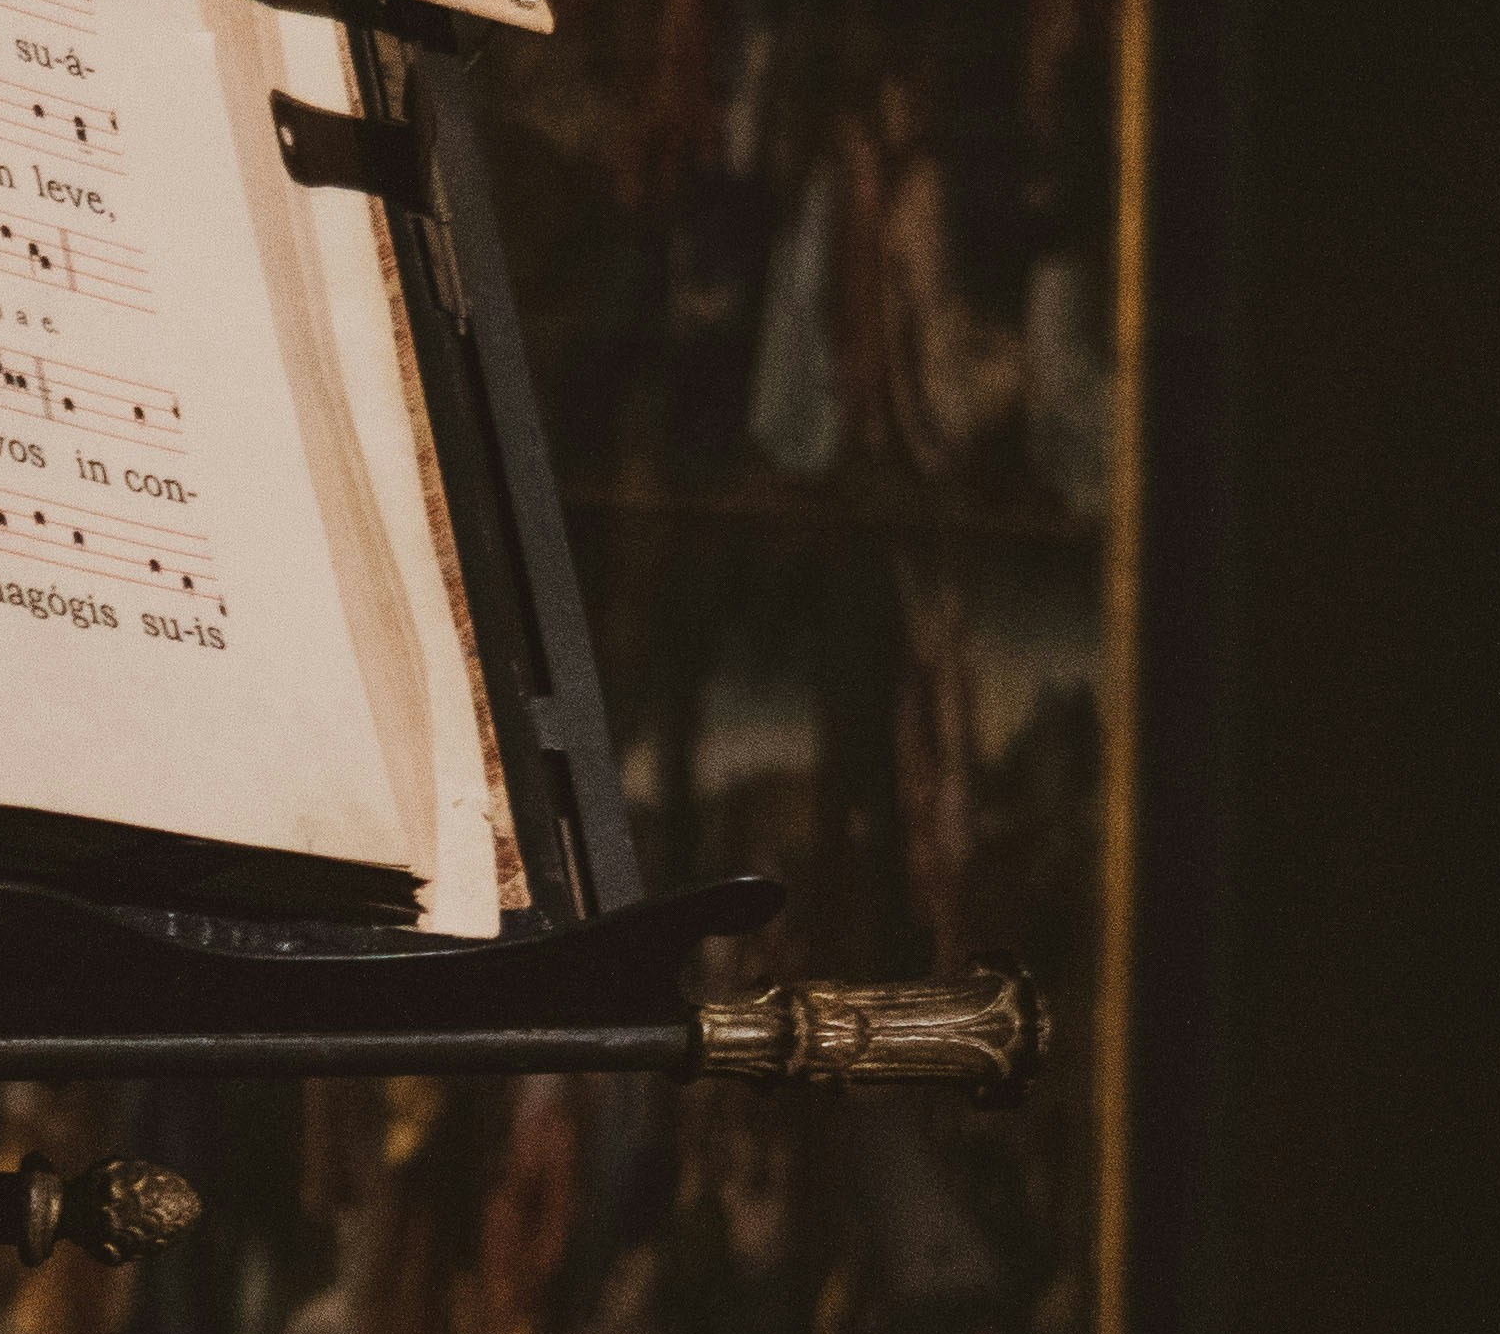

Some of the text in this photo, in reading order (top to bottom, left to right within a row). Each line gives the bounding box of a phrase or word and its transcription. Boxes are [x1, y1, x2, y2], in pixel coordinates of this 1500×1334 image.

[33, 163, 118, 224] leve,
[74, 448, 112, 487] in
[123, 464, 198, 506] con-
